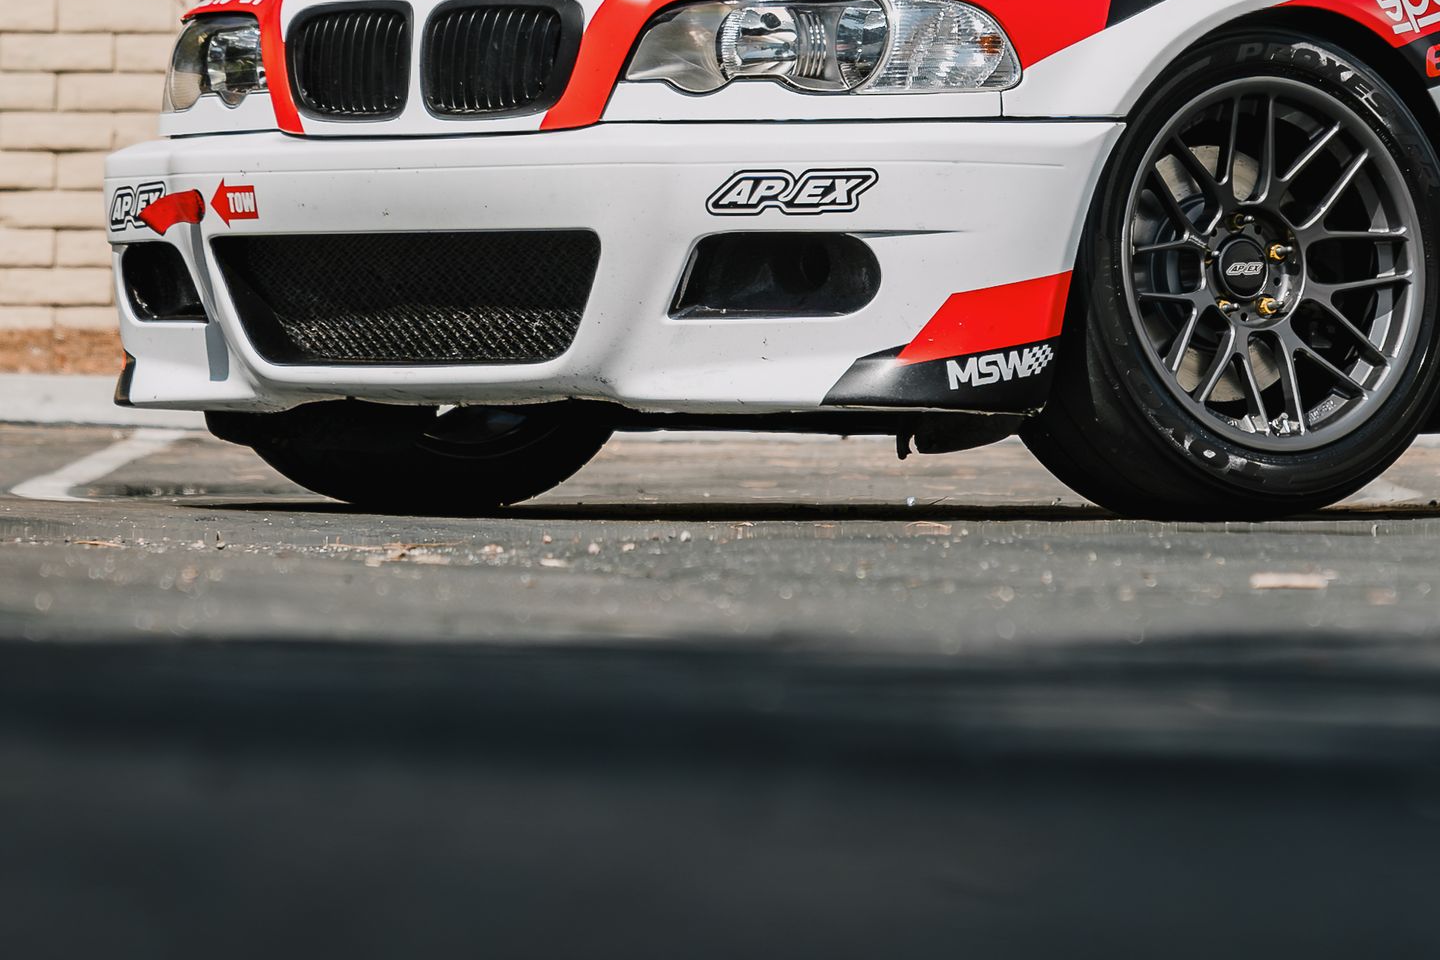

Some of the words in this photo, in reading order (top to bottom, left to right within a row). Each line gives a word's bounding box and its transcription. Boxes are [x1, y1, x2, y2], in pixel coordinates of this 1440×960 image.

[226, 191, 255, 213] TOW
[715, 177, 865, 207] APEX
[946, 348, 1029, 390] MSW
